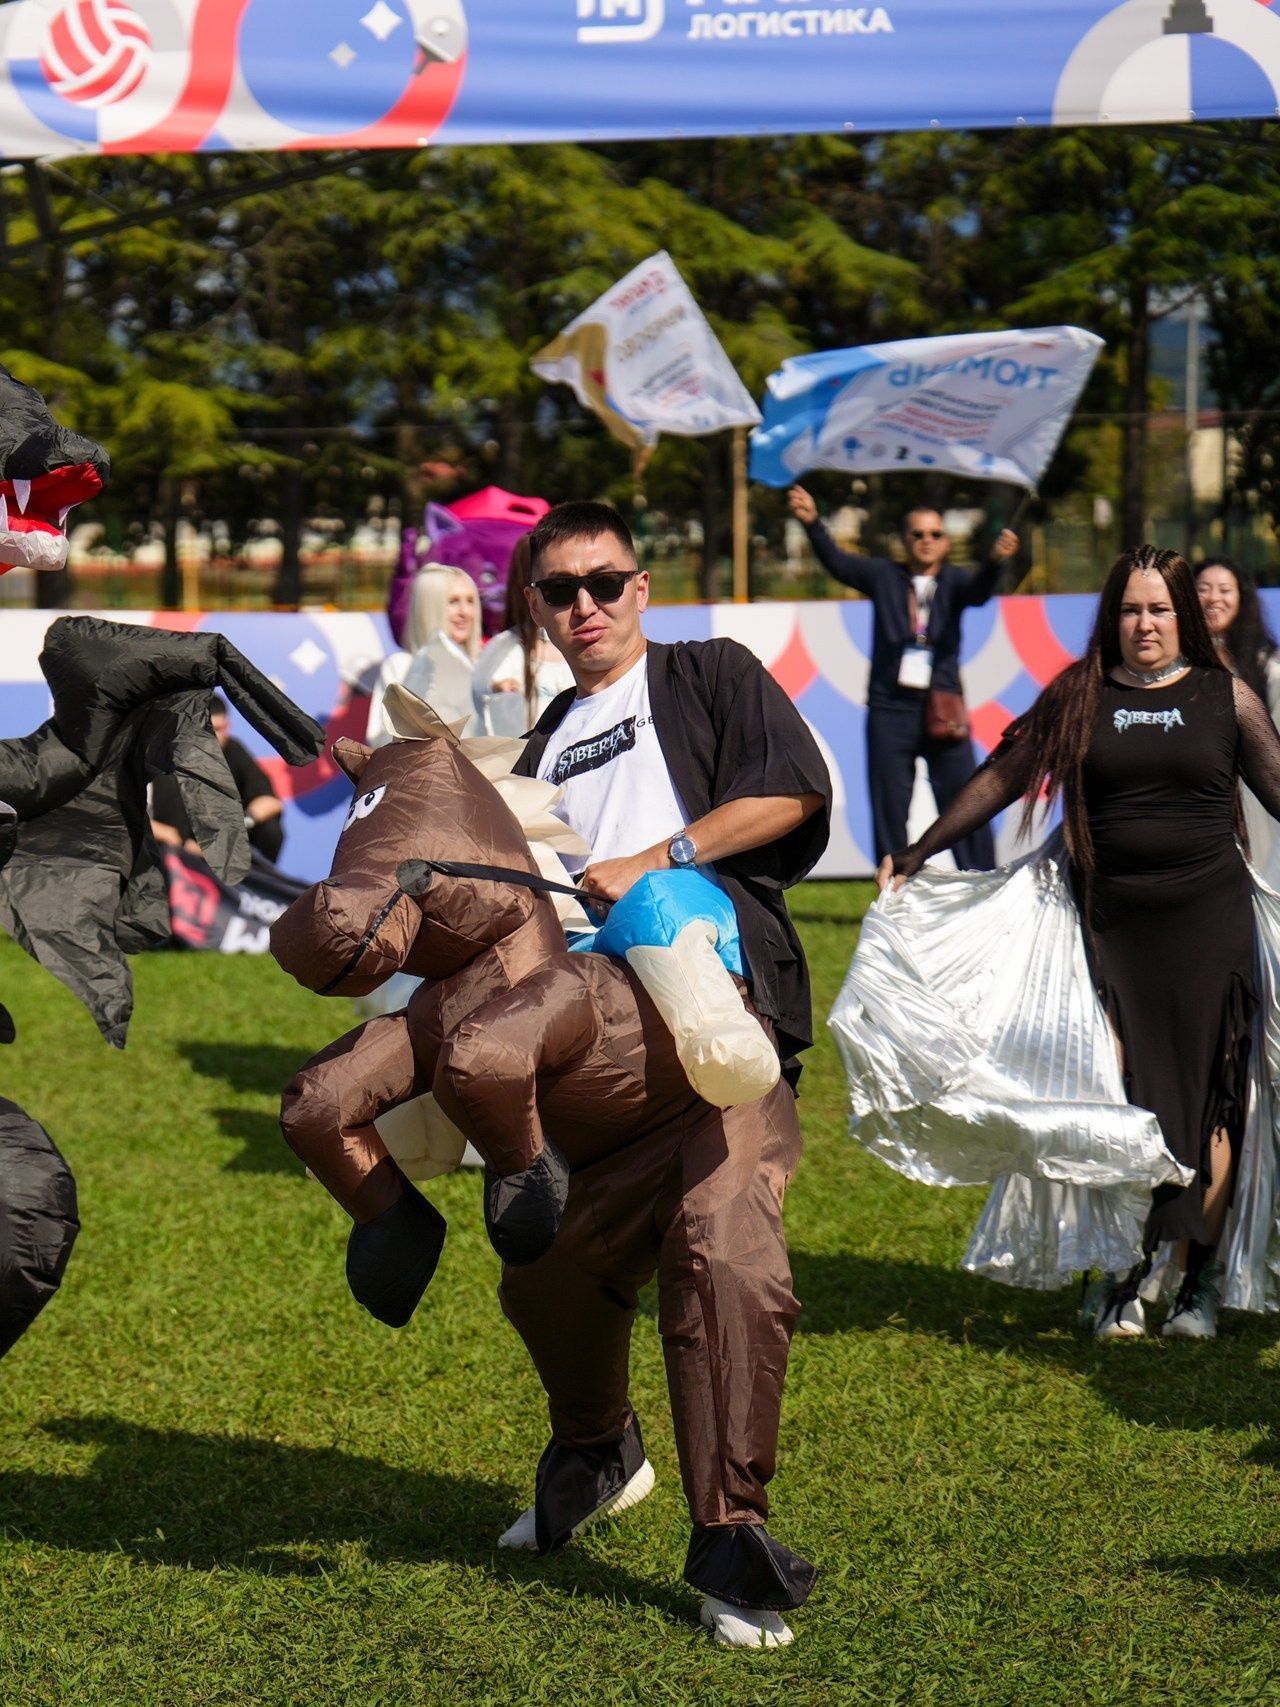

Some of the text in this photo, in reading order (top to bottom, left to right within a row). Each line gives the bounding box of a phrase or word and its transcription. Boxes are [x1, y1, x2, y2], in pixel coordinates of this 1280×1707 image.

[686, 8, 895, 39] ЛОГИСТИКА
[1113, 707, 1186, 732] SIBERIA
[557, 723, 630, 773] SIBERIA
